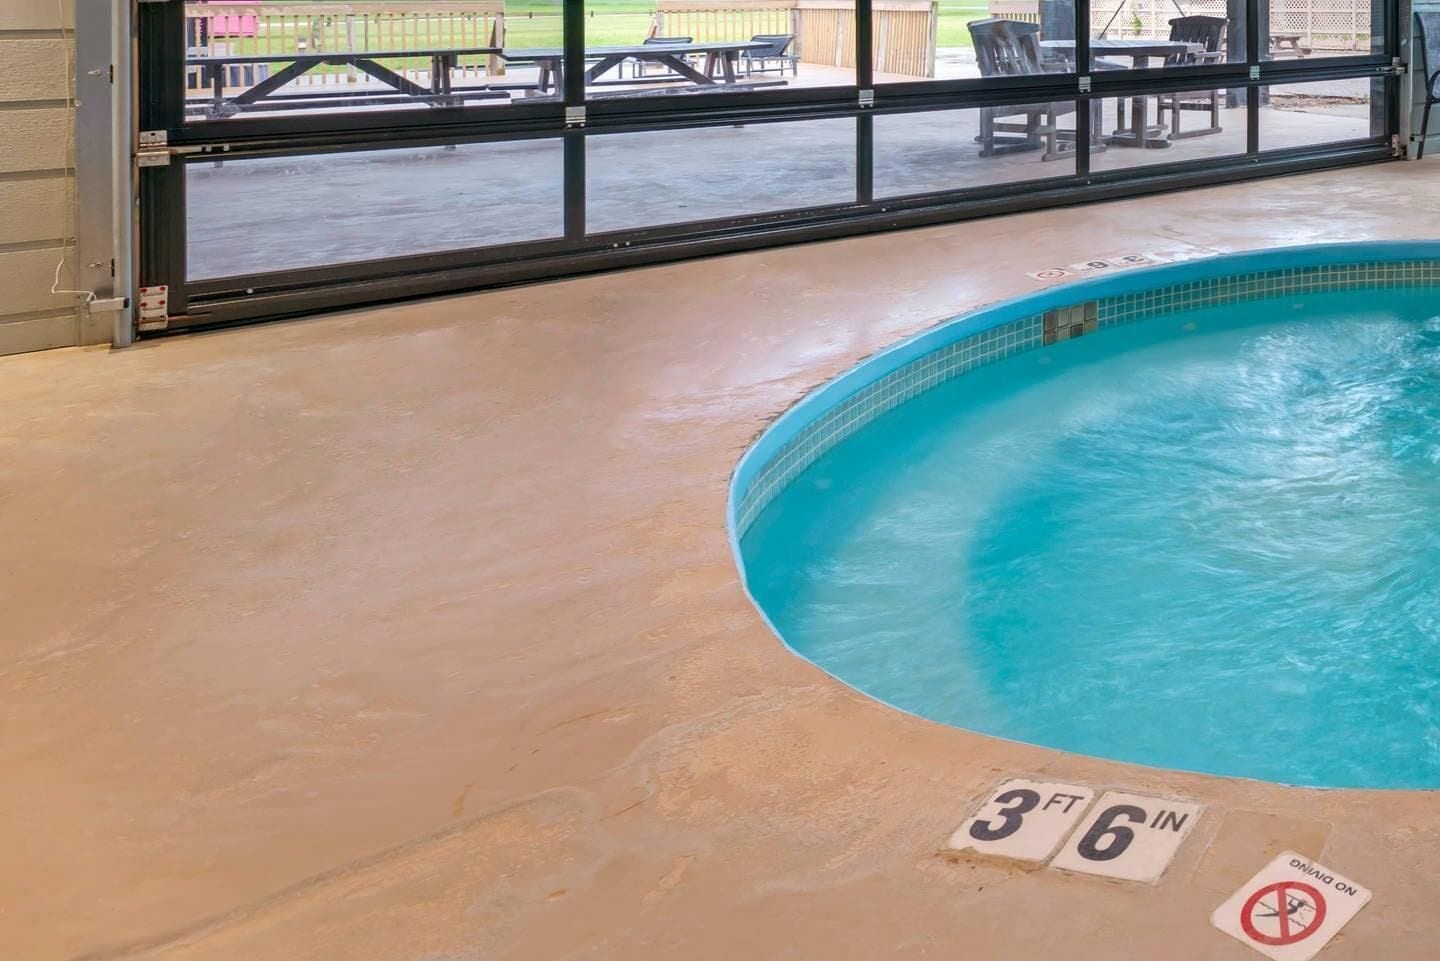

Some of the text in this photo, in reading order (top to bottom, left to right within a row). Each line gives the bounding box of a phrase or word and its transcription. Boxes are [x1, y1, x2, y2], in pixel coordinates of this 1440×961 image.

[969, 788, 1189, 862] 3 FT 6 IN
[1289, 858, 1357, 896] NO DIVING
